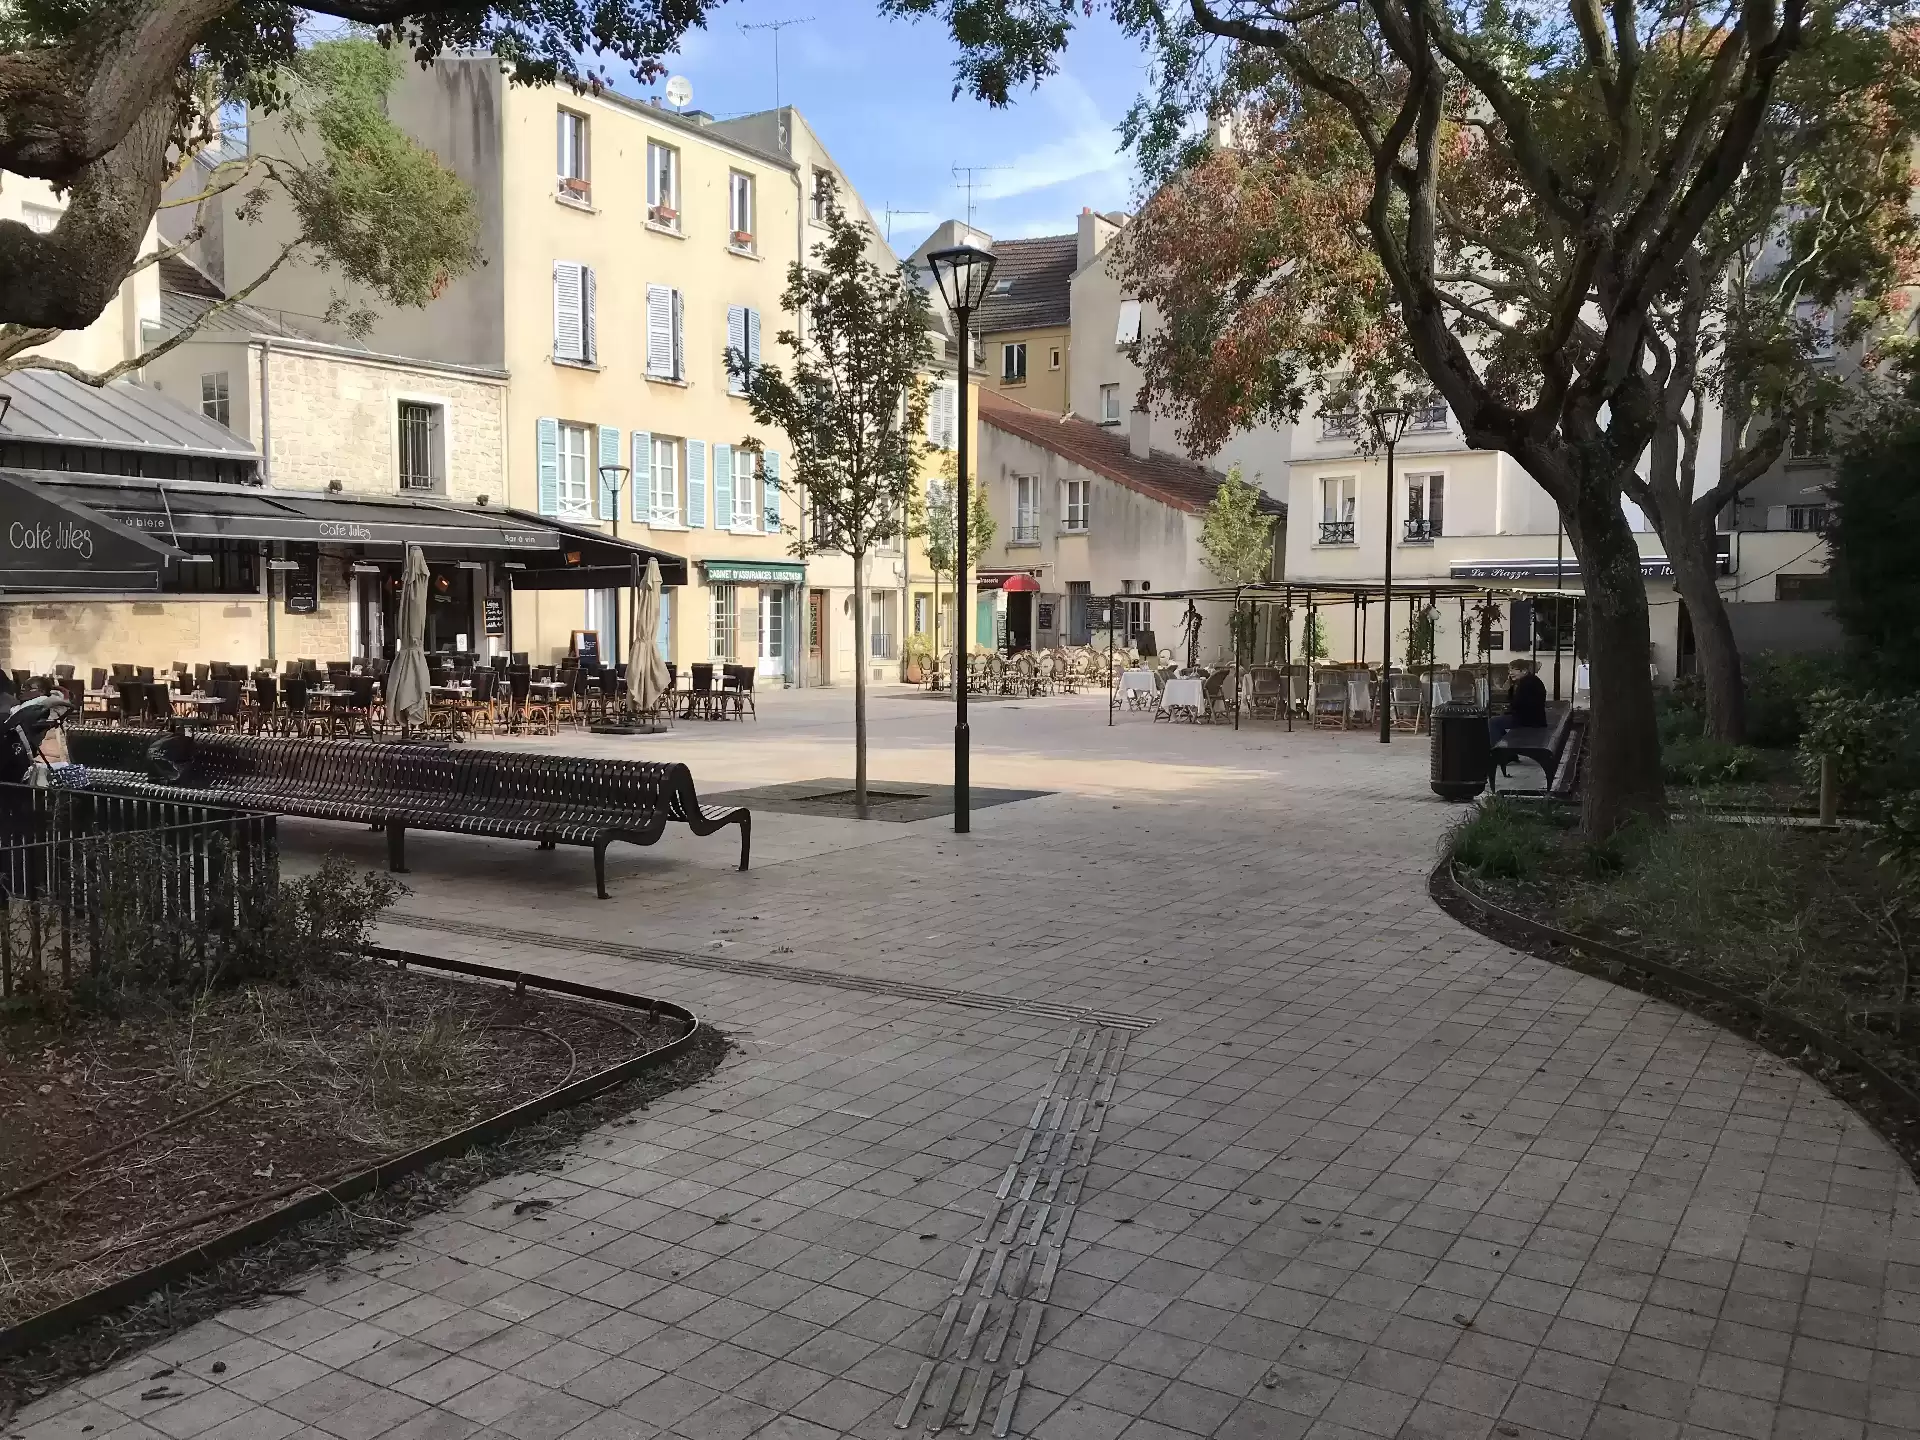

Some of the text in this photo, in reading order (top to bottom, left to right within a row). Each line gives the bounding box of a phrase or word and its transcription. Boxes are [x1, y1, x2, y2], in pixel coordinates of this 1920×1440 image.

[319, 522, 372, 540] Café Jules
[9, 521, 93, 558] Café Jules
[504, 534, 517, 543] Bar
[709, 569, 732, 579] CABINET
[1470, 568, 1530, 580] La Piazza
